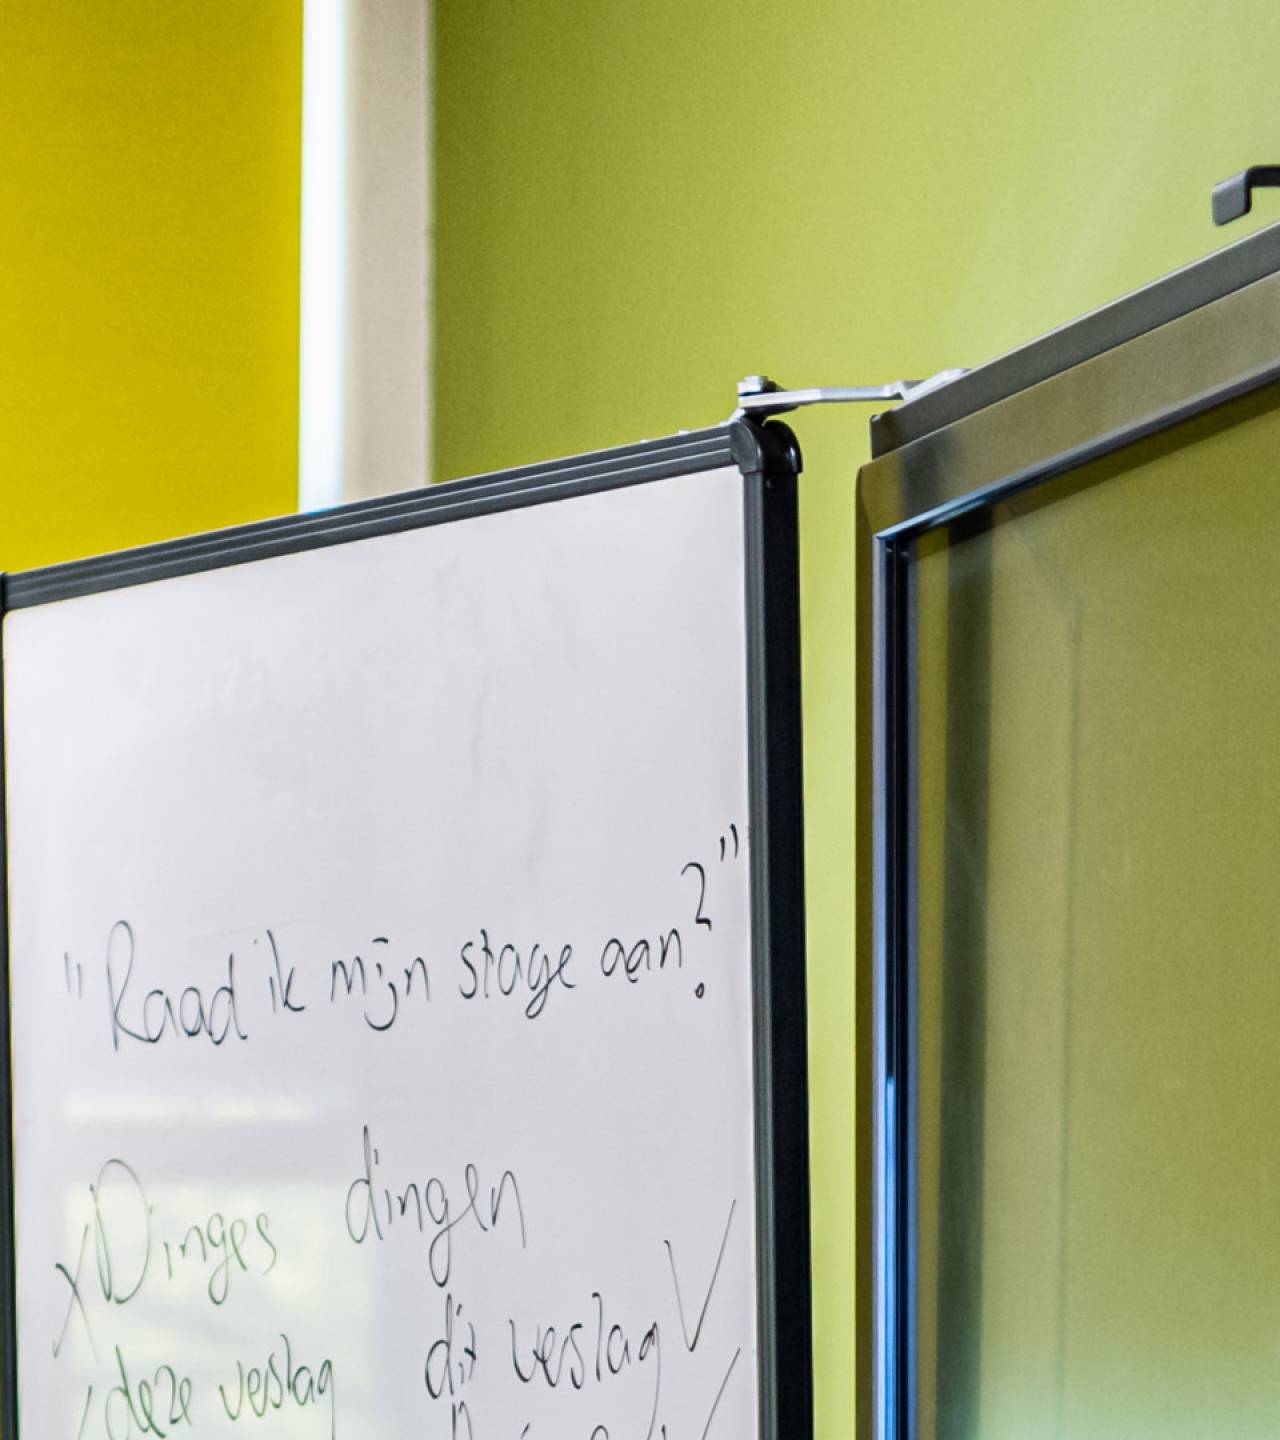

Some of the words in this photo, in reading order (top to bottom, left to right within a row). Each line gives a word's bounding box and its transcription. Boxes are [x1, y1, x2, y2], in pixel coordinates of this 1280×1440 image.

[252, 928, 307, 1014] ik
[330, 936, 431, 1032] mijn
[458, 928, 577, 1019] stage
[89, 1157, 277, 1306] Dinges
[345, 1123, 527, 1288] dingen
[425, 1293, 477, 1400] dit
